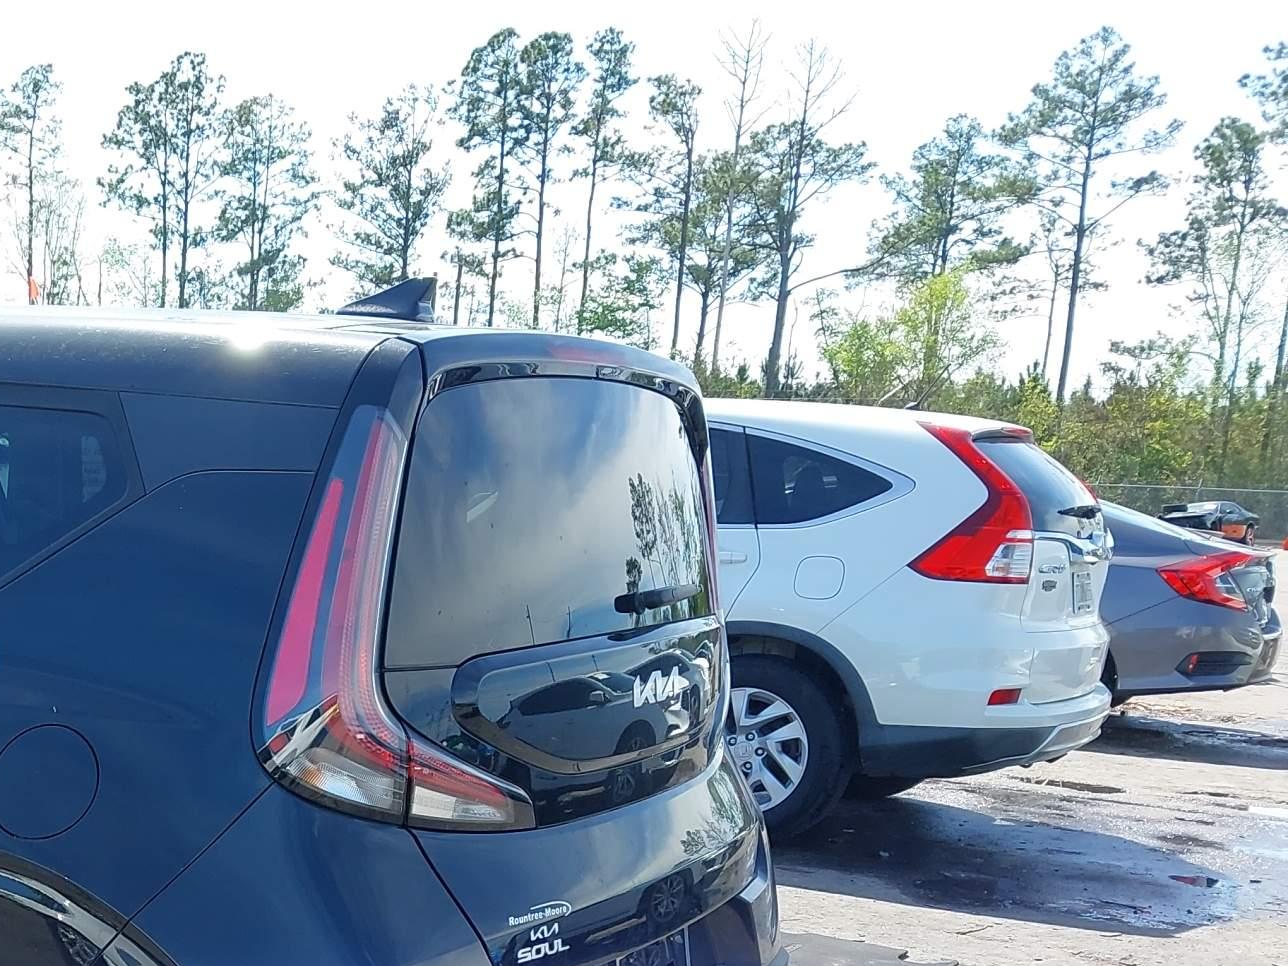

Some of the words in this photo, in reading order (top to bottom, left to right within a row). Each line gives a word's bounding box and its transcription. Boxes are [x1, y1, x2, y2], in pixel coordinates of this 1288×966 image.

[633, 665, 680, 708] KIA
[530, 922, 559, 941] KIA
[517, 938, 570, 963] SOUL
